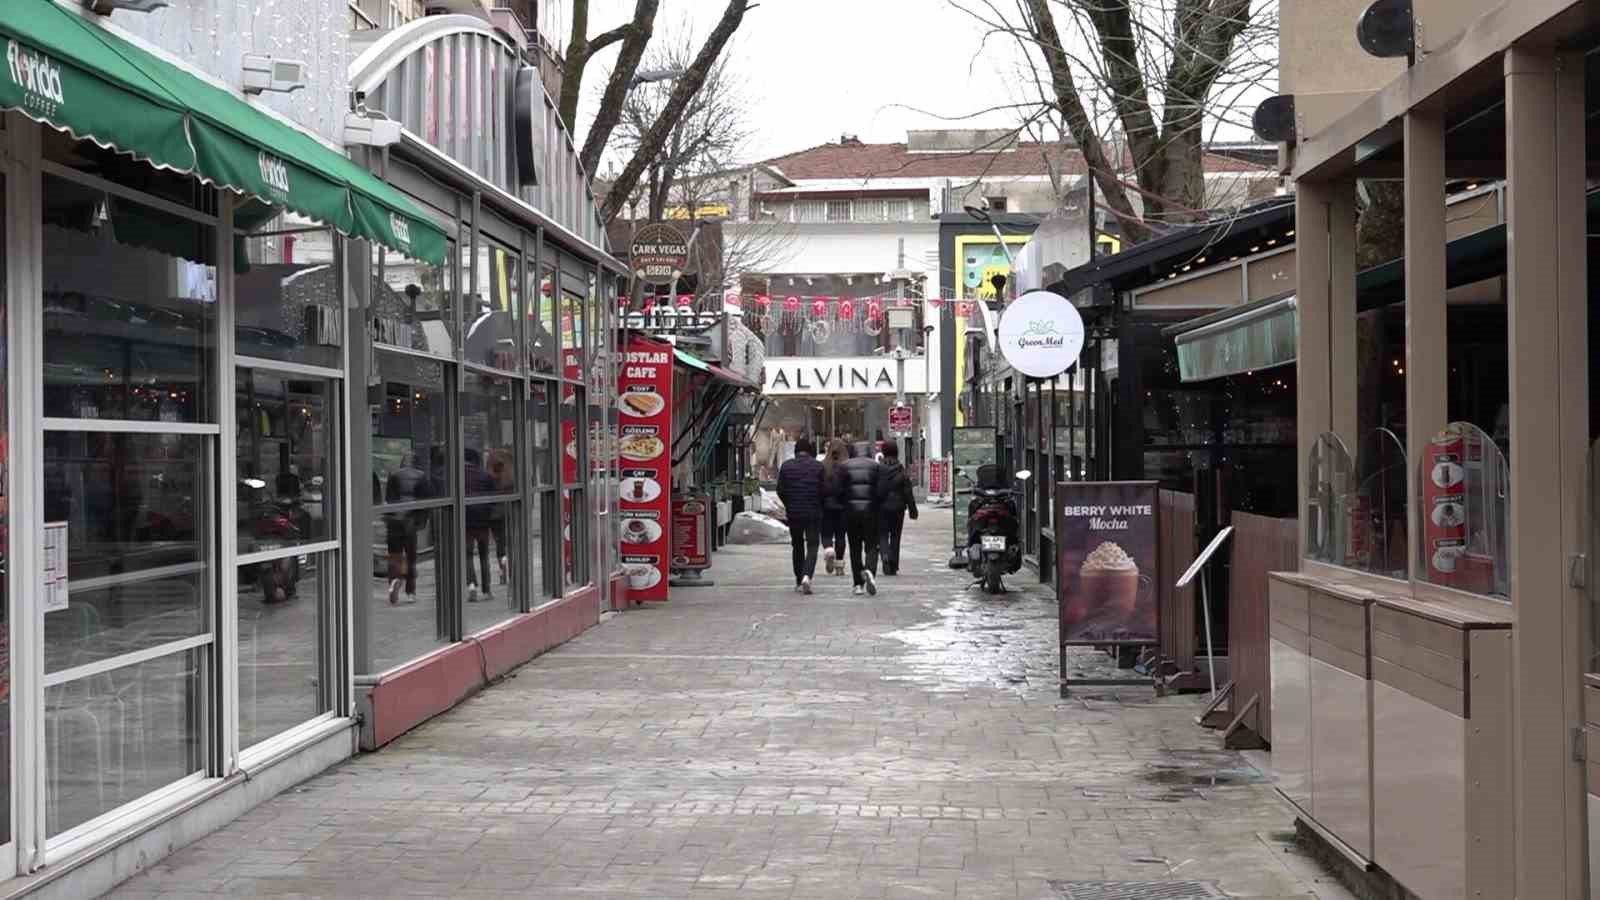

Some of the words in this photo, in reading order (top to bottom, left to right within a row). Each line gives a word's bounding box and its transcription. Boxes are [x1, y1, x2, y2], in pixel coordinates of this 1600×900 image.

[658, 244, 687, 255] VEGAS
[1017, 336, 1042, 349] Green
[1043, 335, 1064, 345] Med
[627, 366, 657, 379] CAFE
[771, 364, 894, 389] ALVİNA
[1064, 505, 1106, 516] BERRY
[1109, 504, 1152, 516] WHITE
[1088, 516, 1128, 530] Mocha
